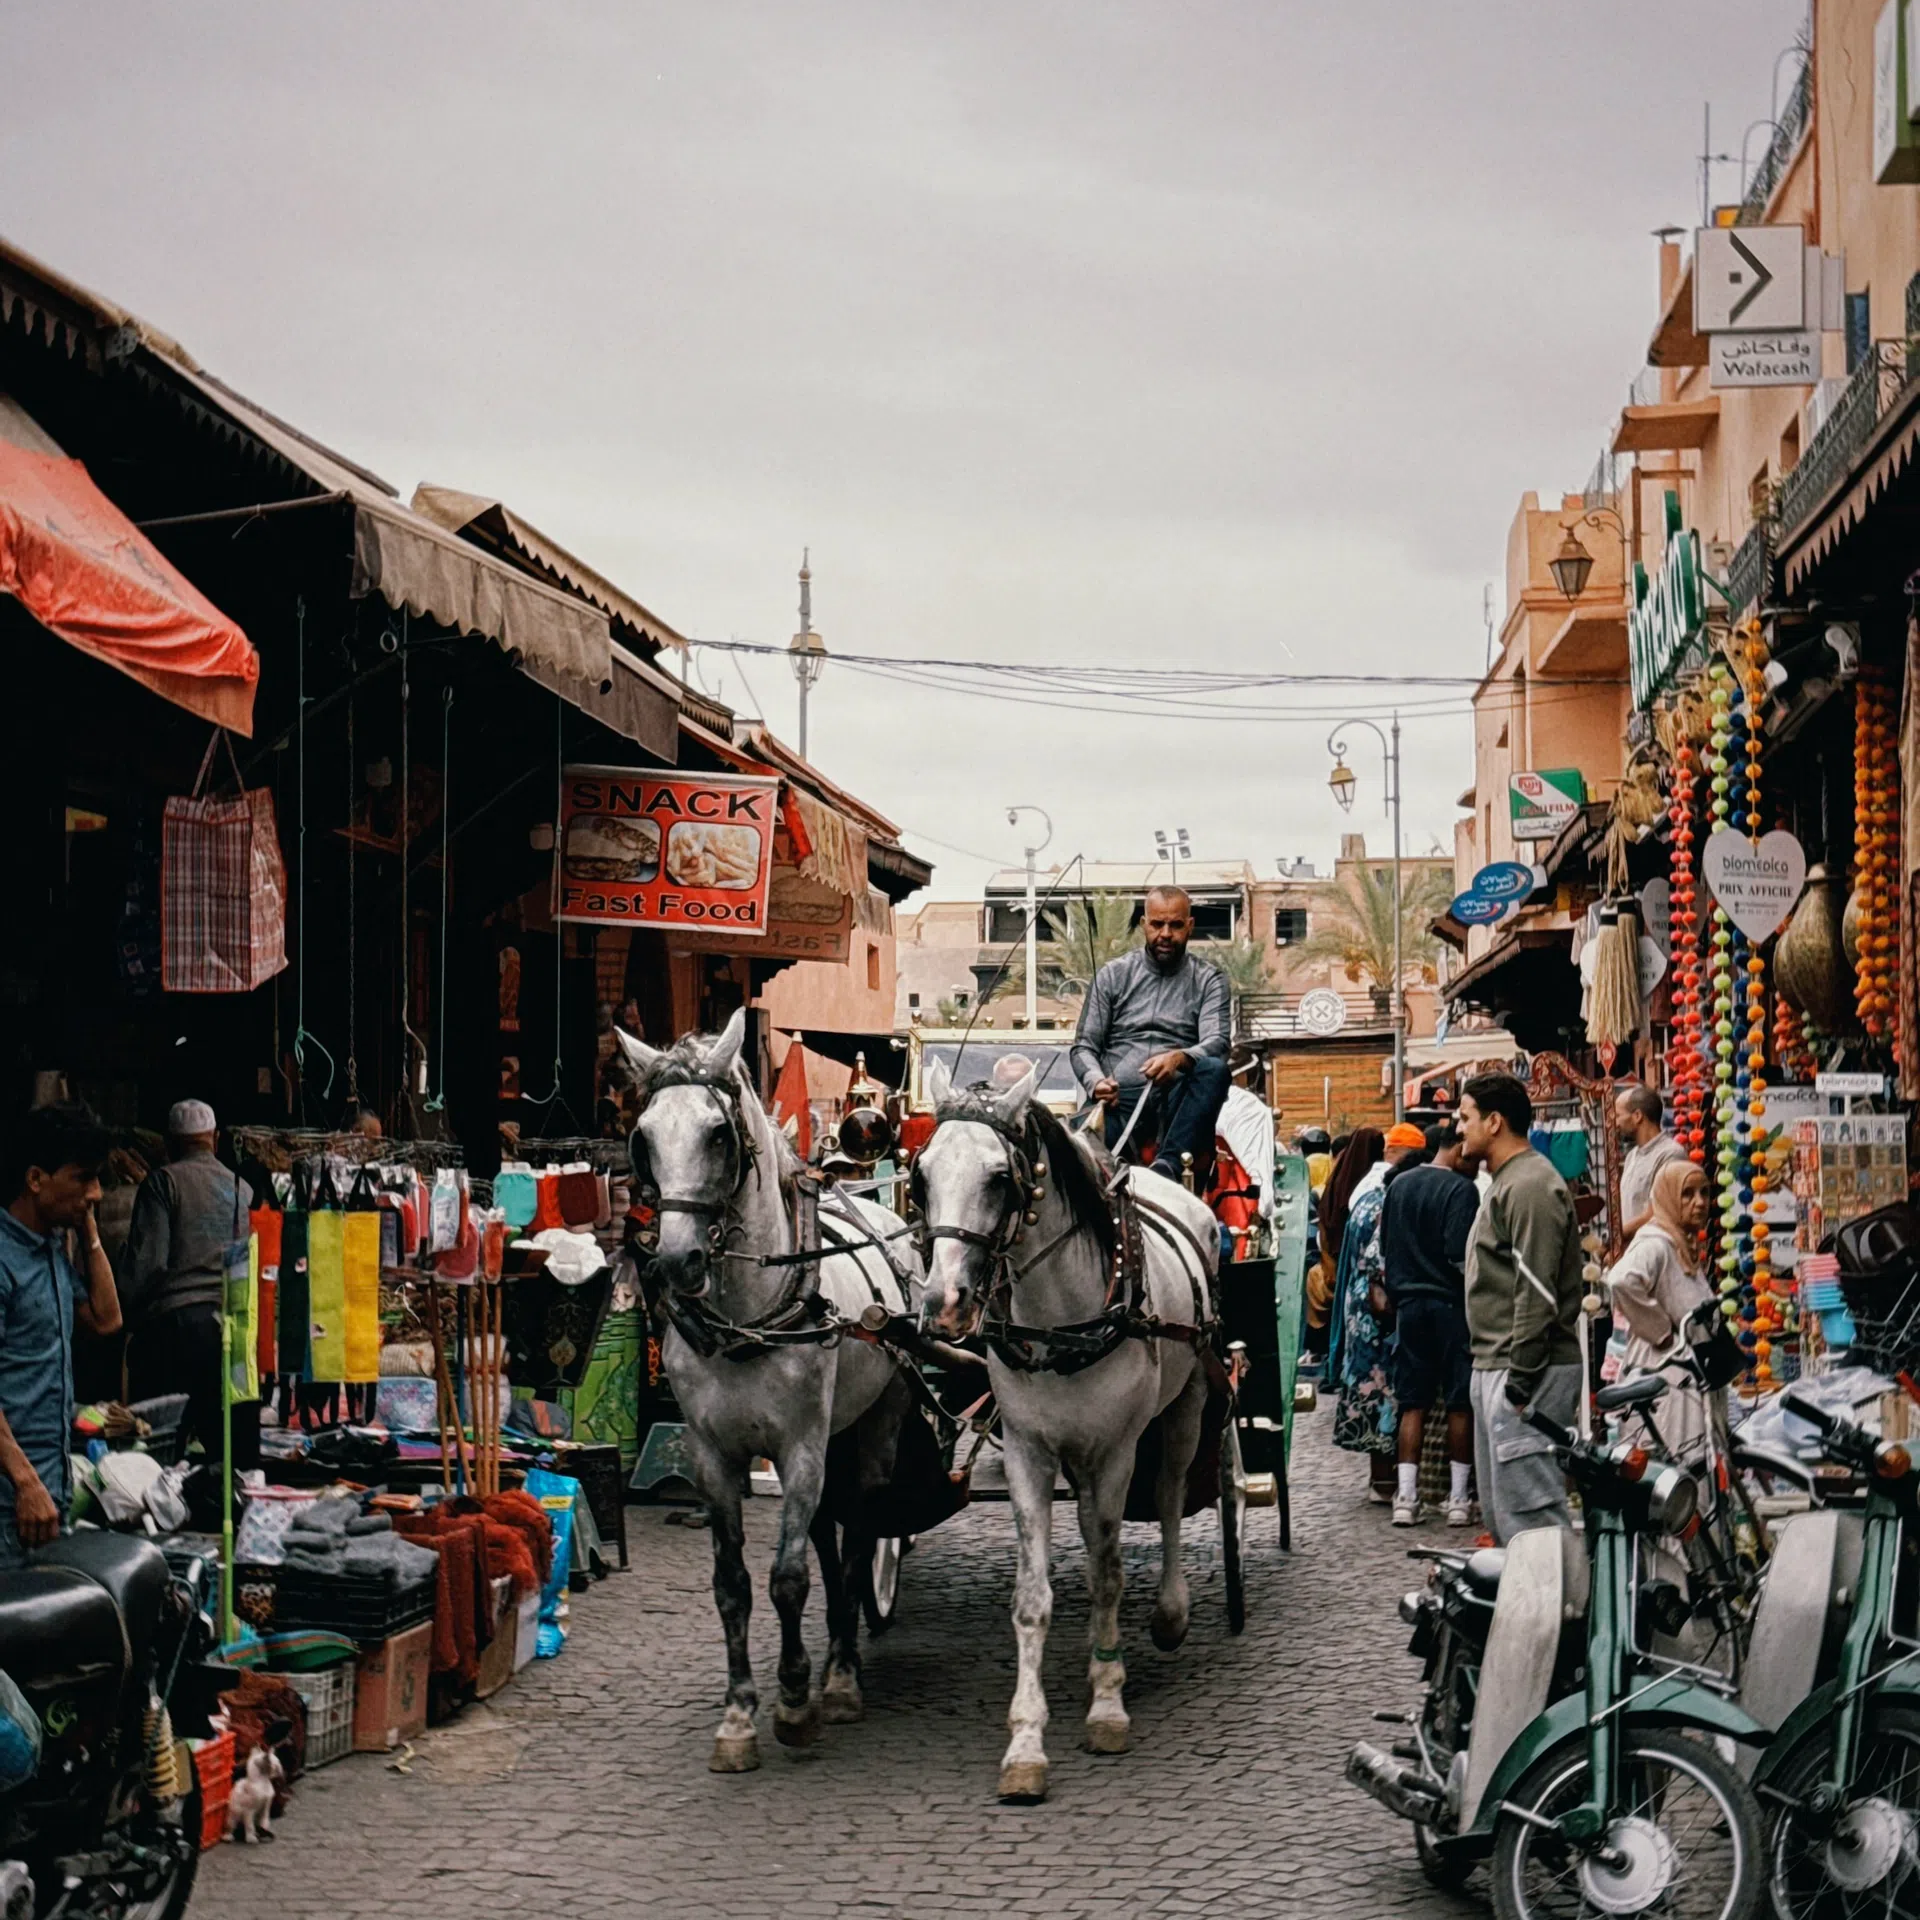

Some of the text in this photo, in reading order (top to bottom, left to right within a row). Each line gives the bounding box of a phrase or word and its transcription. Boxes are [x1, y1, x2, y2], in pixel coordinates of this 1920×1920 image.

[1721, 337, 1811, 359] وفاكاش
[1722, 361, 1811, 377] Wafacash
[572, 783, 763, 821] SNACK
[1719, 883, 1743, 895] PRIX
[562, 888, 757, 922] Fast Food
